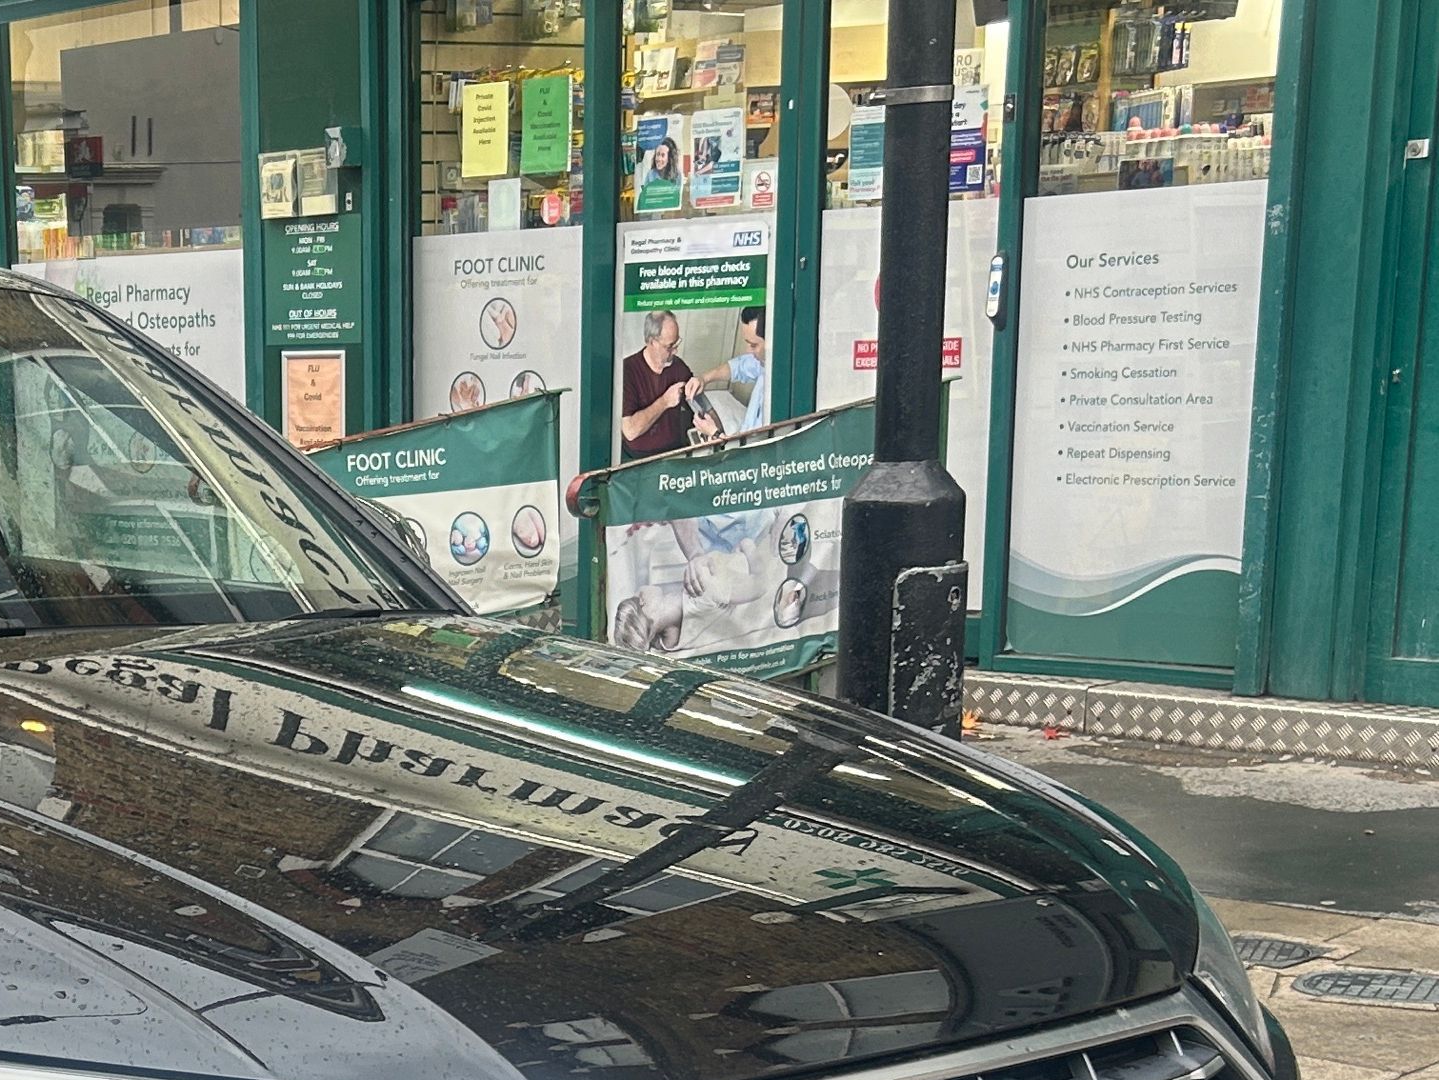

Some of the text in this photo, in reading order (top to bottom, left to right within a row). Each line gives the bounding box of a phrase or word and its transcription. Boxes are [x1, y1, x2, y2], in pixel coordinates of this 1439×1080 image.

[285, 222, 339, 233] OPENING HOURS
[631, 238, 646, 246] Regal
[733, 231, 762, 247] NHS
[454, 255, 545, 275] FOOT CLINIC
[1066, 252, 1159, 269] Our Services
[639, 261, 751, 278] Free blood pressure checks
[460, 275, 538, 290] Offering treatment for
[640, 275, 749, 290] available in this pharmacy
[1074, 281, 1238, 299] NHS Contraception Services
[86, 283, 191, 308] Regal Pharmacy
[137, 309, 216, 333] Osteopaths
[289, 308, 337, 318] OUT OF HOURS
[1073, 310, 1202, 326] Blood Pressure Testing
[185, 341, 200, 356] for
[1071, 337, 1230, 354] NHS Pharmacy First Service
[307, 364, 320, 373] FLU
[1070, 366, 1177, 381] Smoking Cessation
[304, 392, 322, 401] Covid
[1069, 392, 1213, 406] Private Consultation Area
[295, 424, 332, 433] Vaccination
[1067, 420, 1174, 433] Vaccination Service
[347, 448, 447, 472] FOOT CLINIC
[1066, 447, 1170, 462] Repeat Dispensing
[355, 470, 440, 487] Offering treatment for
[658, 453, 874, 493] Regal Pharmacy Registered Osteopa
[1065, 473, 1236, 489] Electronic Prescription Service
[712, 475, 842, 507] offering treatments for
